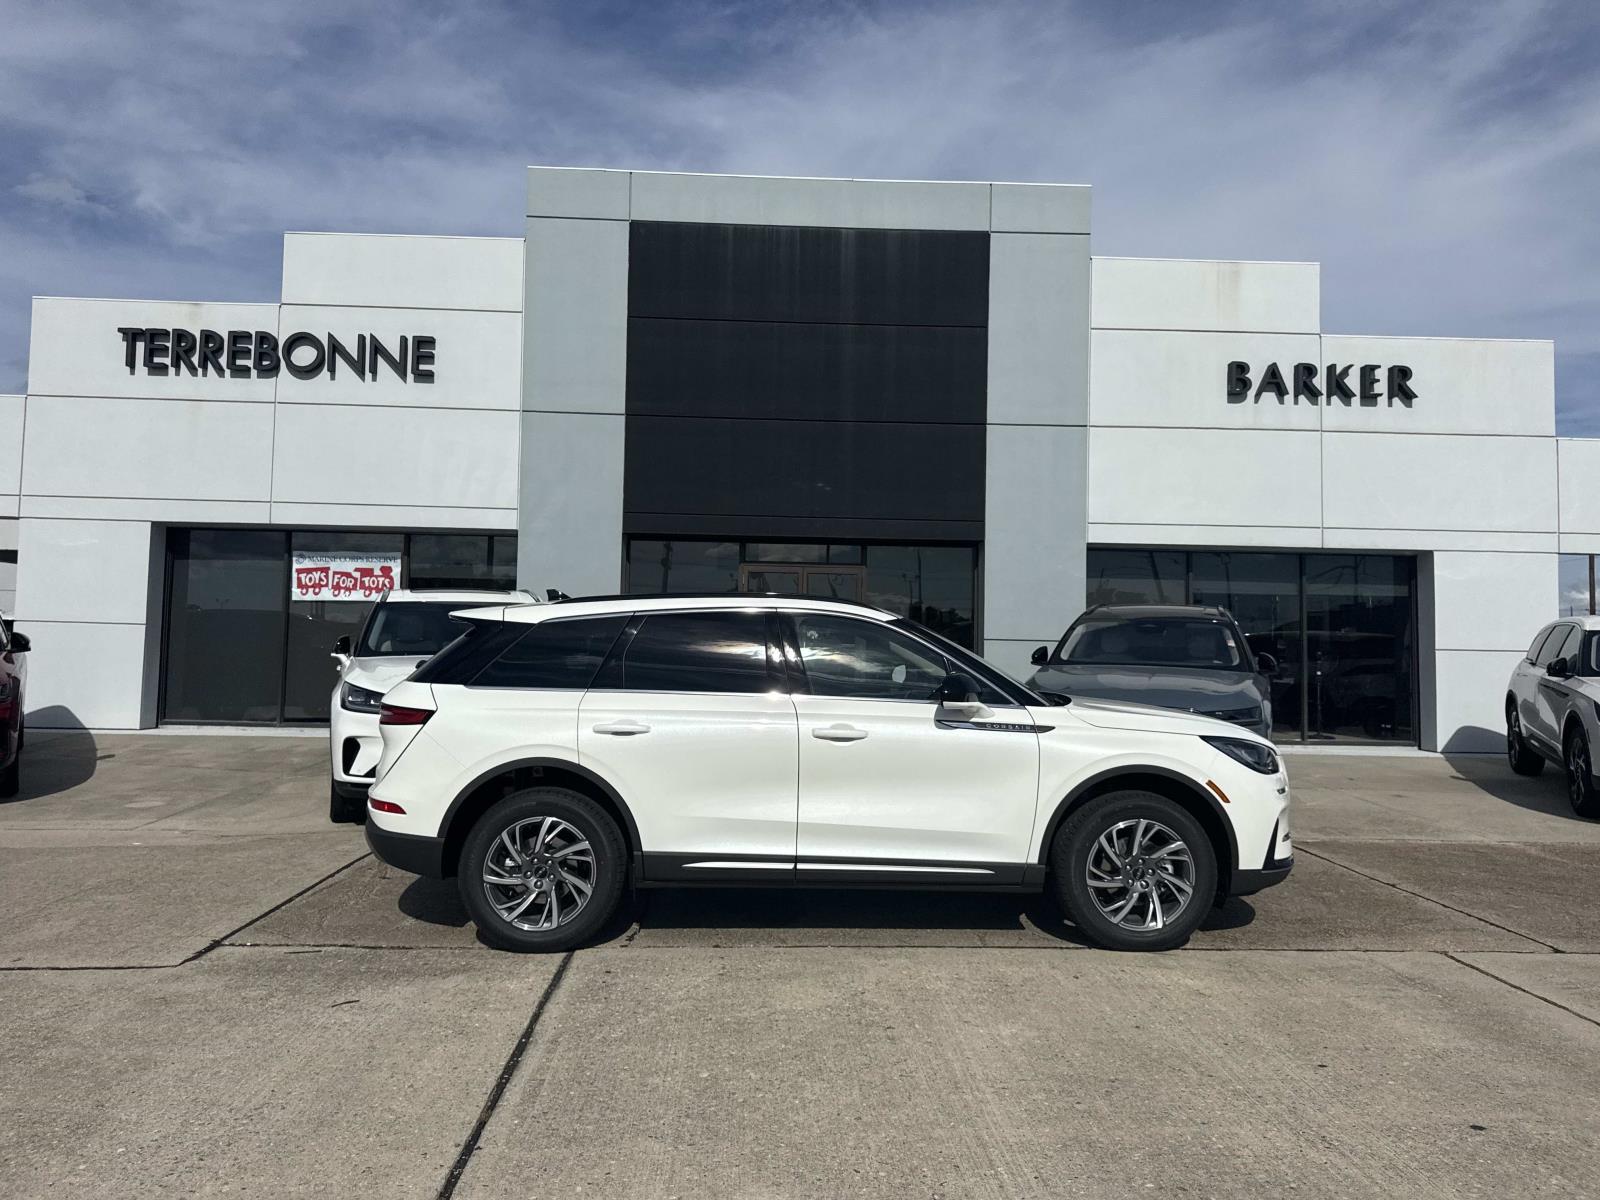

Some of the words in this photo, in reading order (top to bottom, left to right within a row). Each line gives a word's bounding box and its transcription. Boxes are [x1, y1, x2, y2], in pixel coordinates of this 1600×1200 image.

[118, 327, 435, 384] TERREBONNE
[1227, 361, 1419, 408] BARKER
[308, 555, 336, 563] MARINE
[299, 571, 327, 585] TOYS
[333, 575, 354, 588] FOR
[361, 577, 391, 588] TOTS
